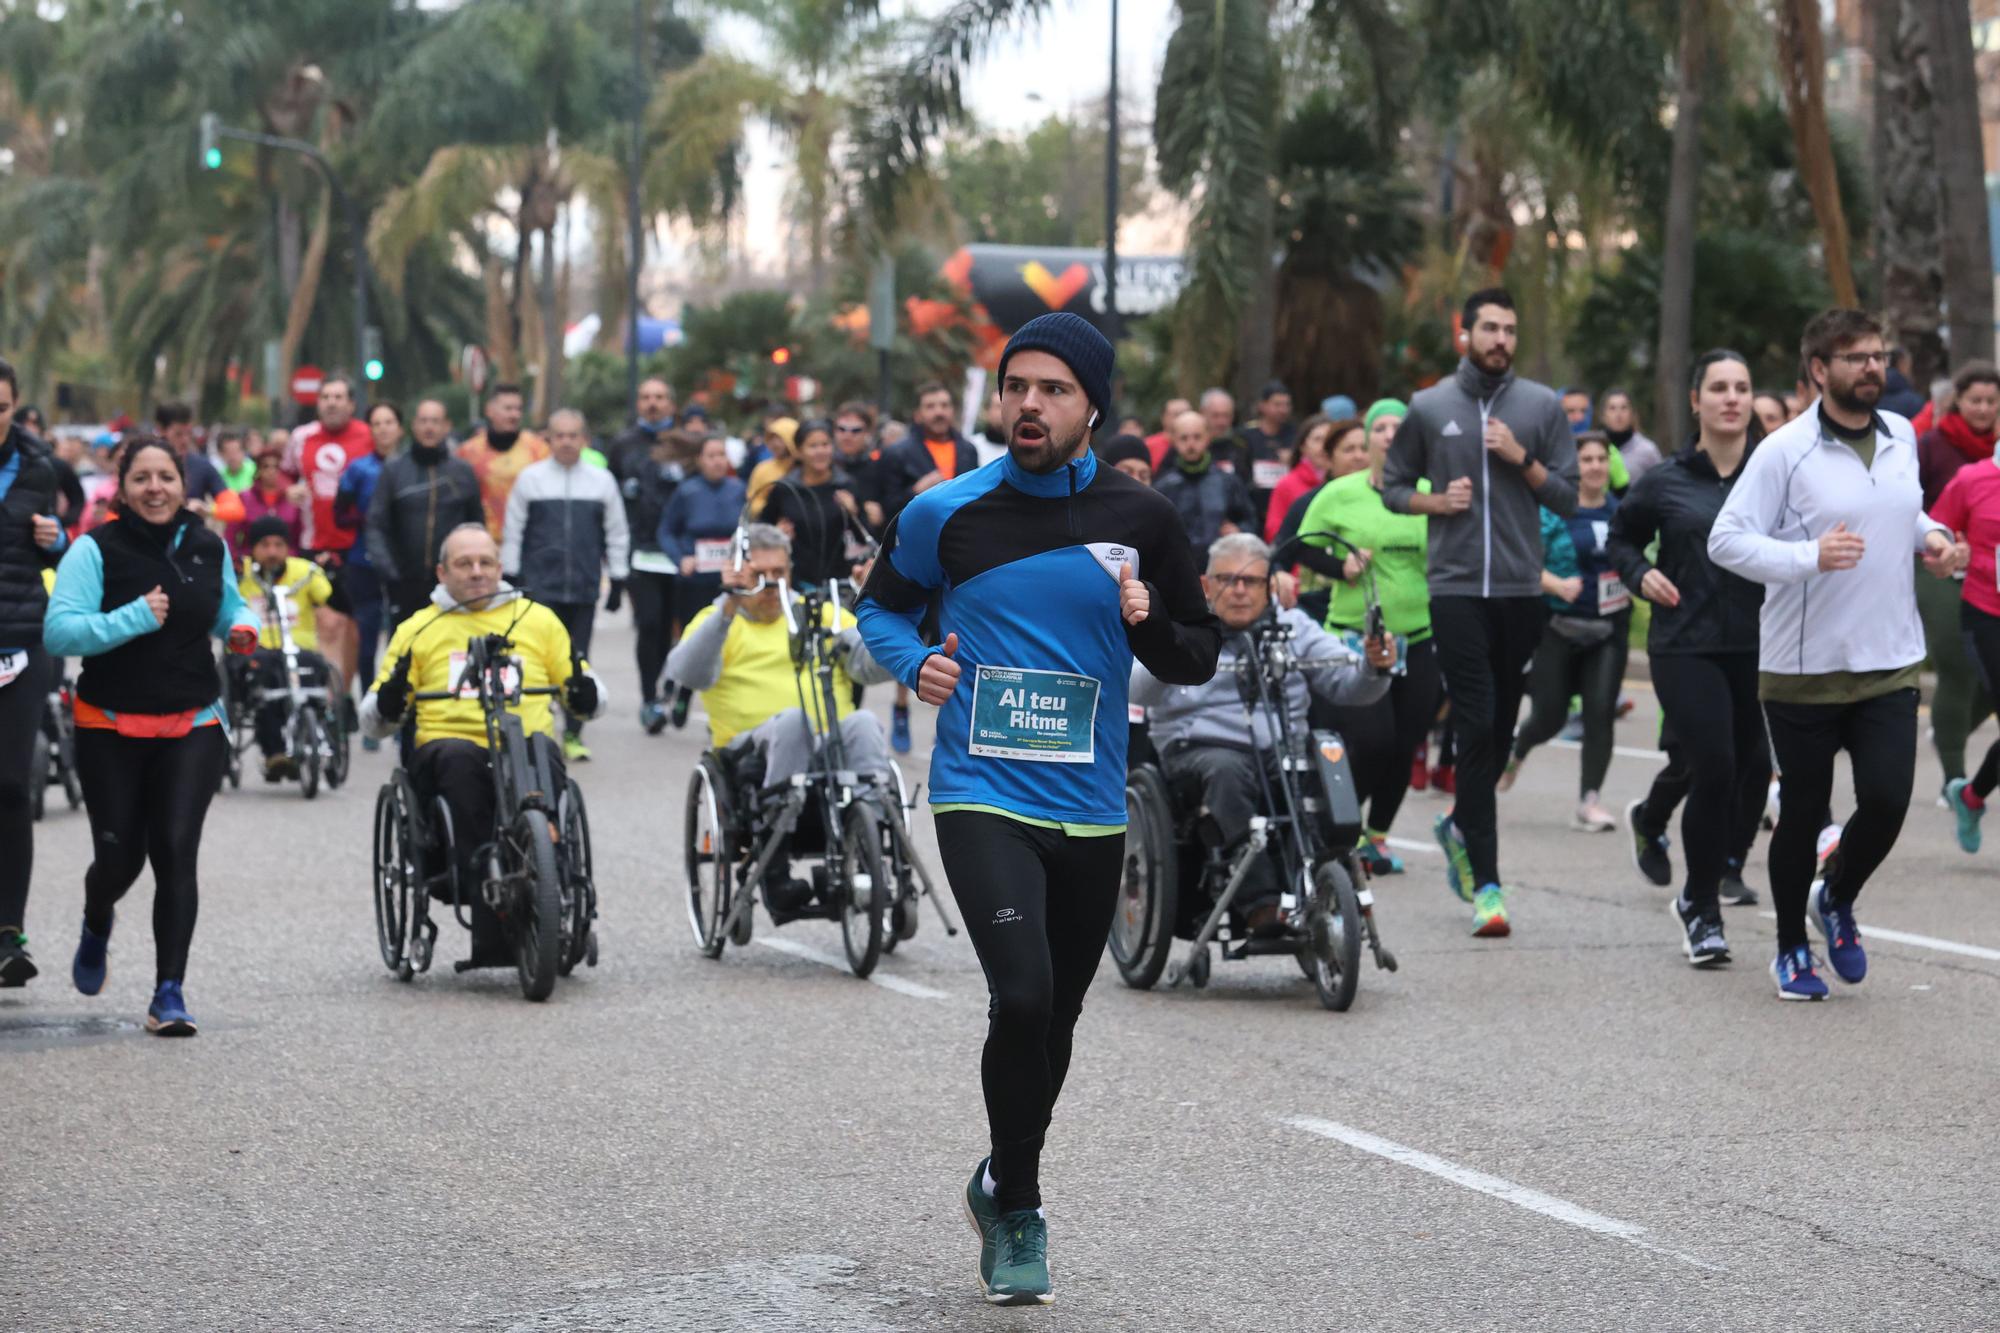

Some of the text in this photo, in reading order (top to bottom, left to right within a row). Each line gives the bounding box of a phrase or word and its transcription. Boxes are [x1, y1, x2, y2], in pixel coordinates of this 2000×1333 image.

[998, 688, 1066, 711] Al teu
[1010, 710, 1068, 731] Ritme
